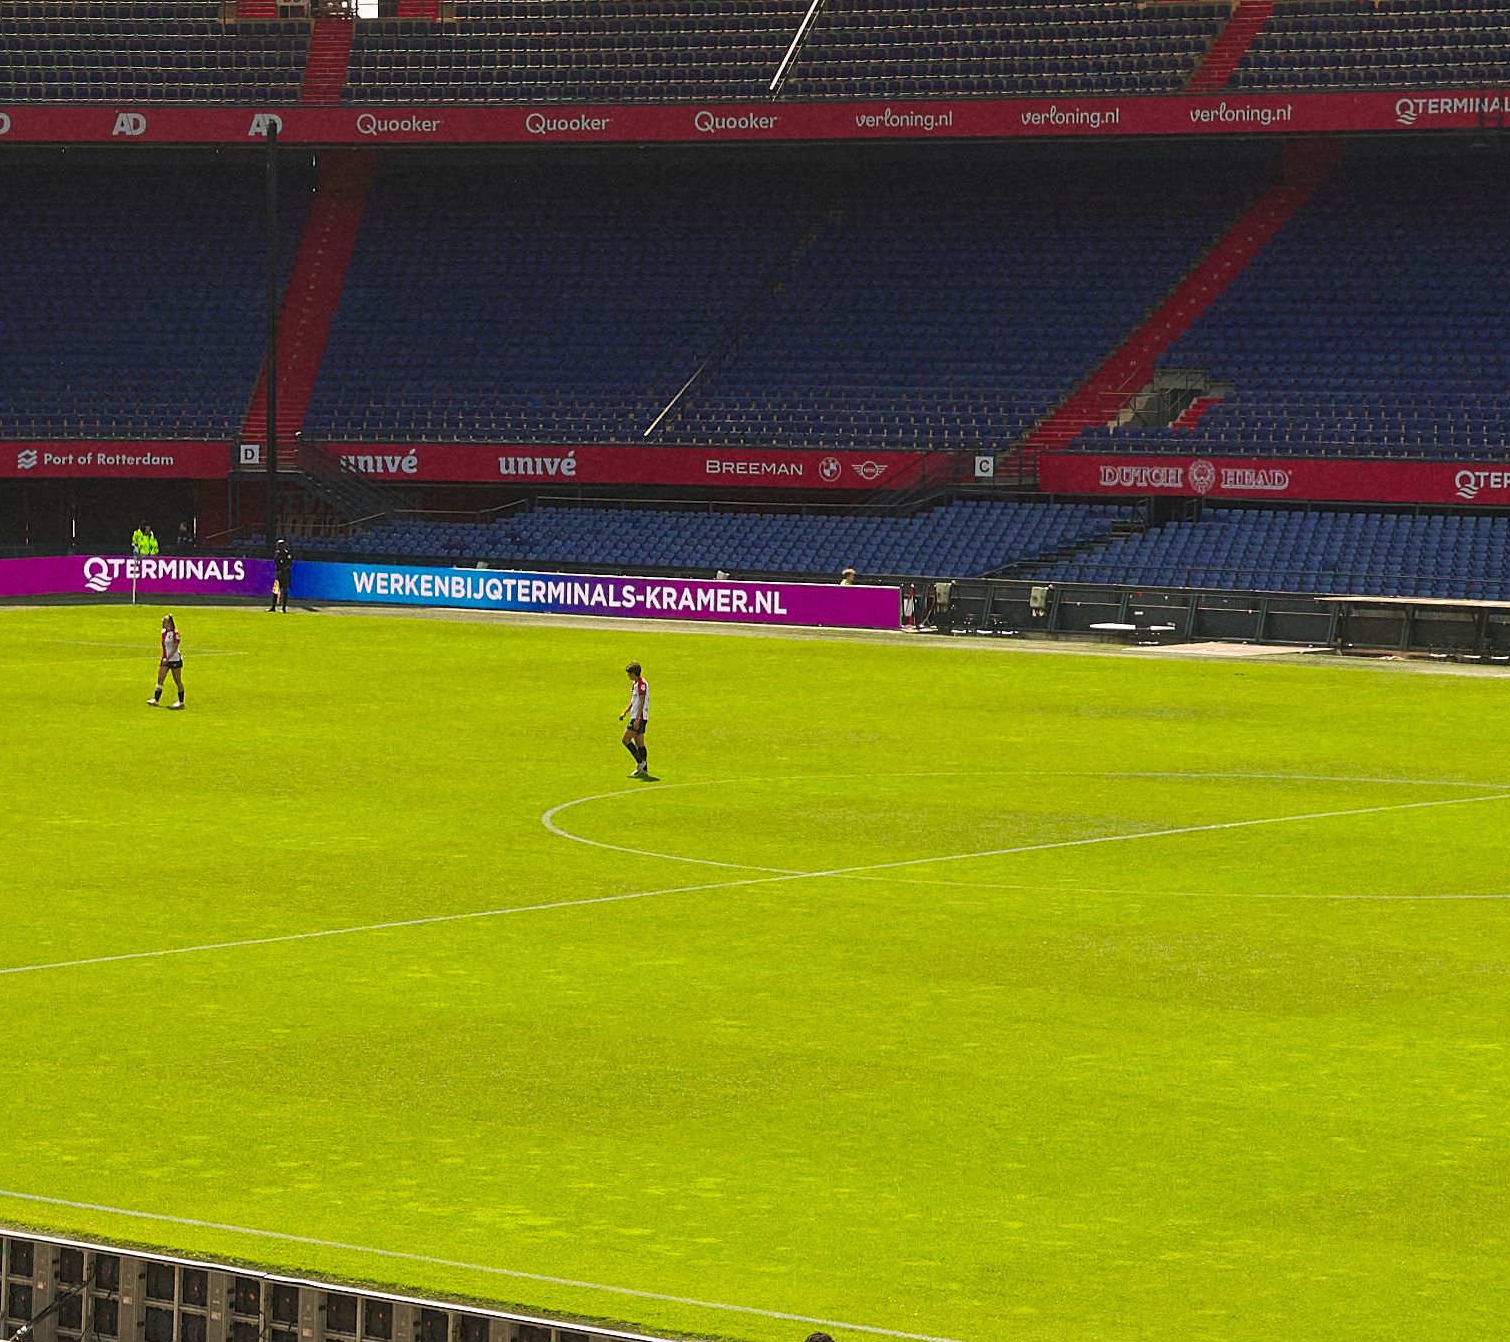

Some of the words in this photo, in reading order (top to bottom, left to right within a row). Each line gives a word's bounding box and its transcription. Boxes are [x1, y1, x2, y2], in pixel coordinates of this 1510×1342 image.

[112, 111, 147, 136] AD
[248, 112, 284, 136] AD
[357, 112, 440, 135] Quooker
[525, 112, 609, 134] Quooker
[694, 110, 778, 132] Quooker
[855, 107, 953, 131] verloning.nl
[1021, 104, 1120, 129] verloning.nl
[1189, 102, 1291, 125] verloning.nl
[44, 452, 75, 465] Port
[78, 452, 94, 465] of
[97, 452, 174, 466] Rotterdam
[339, 448, 418, 474] univé
[498, 450, 577, 476] univé
[706, 459, 804, 476] BREEMAN
[1099, 465, 1184, 488] DUTCH
[1220, 466, 1289, 491] HEAD
[83, 557, 245, 591] QTERMINALS
[352, 571, 788, 615] WERKENBIJQTERMINALS-KRAMER.NL
